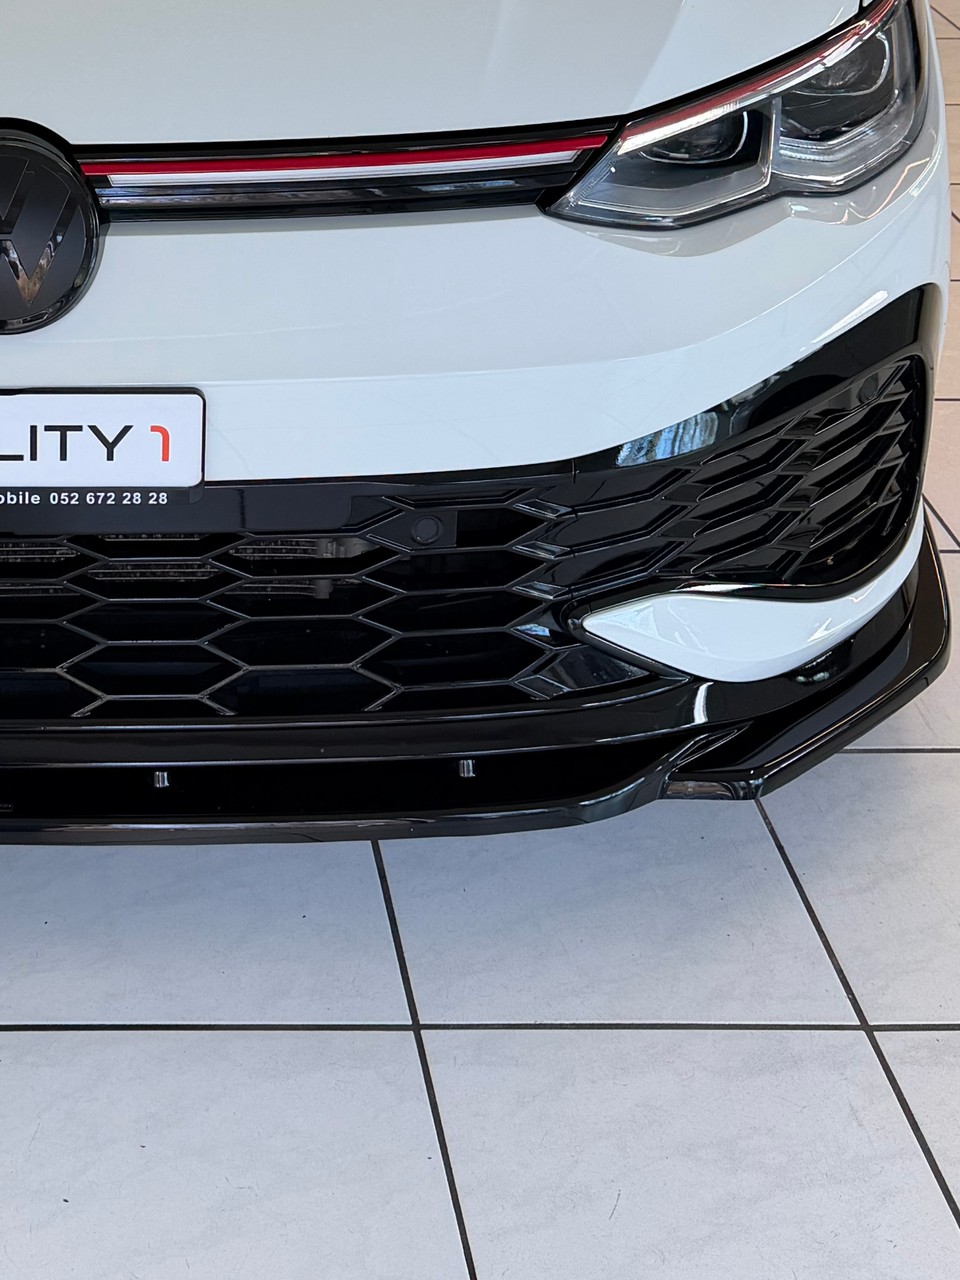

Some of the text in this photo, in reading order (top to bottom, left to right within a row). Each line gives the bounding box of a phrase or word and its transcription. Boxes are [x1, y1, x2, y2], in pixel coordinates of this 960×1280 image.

[150, 424, 170, 462] 1
[49, 492, 79, 505] 052
[86, 492, 116, 505] 672
[122, 492, 142, 505] 28
[148, 492, 168, 505] 28
